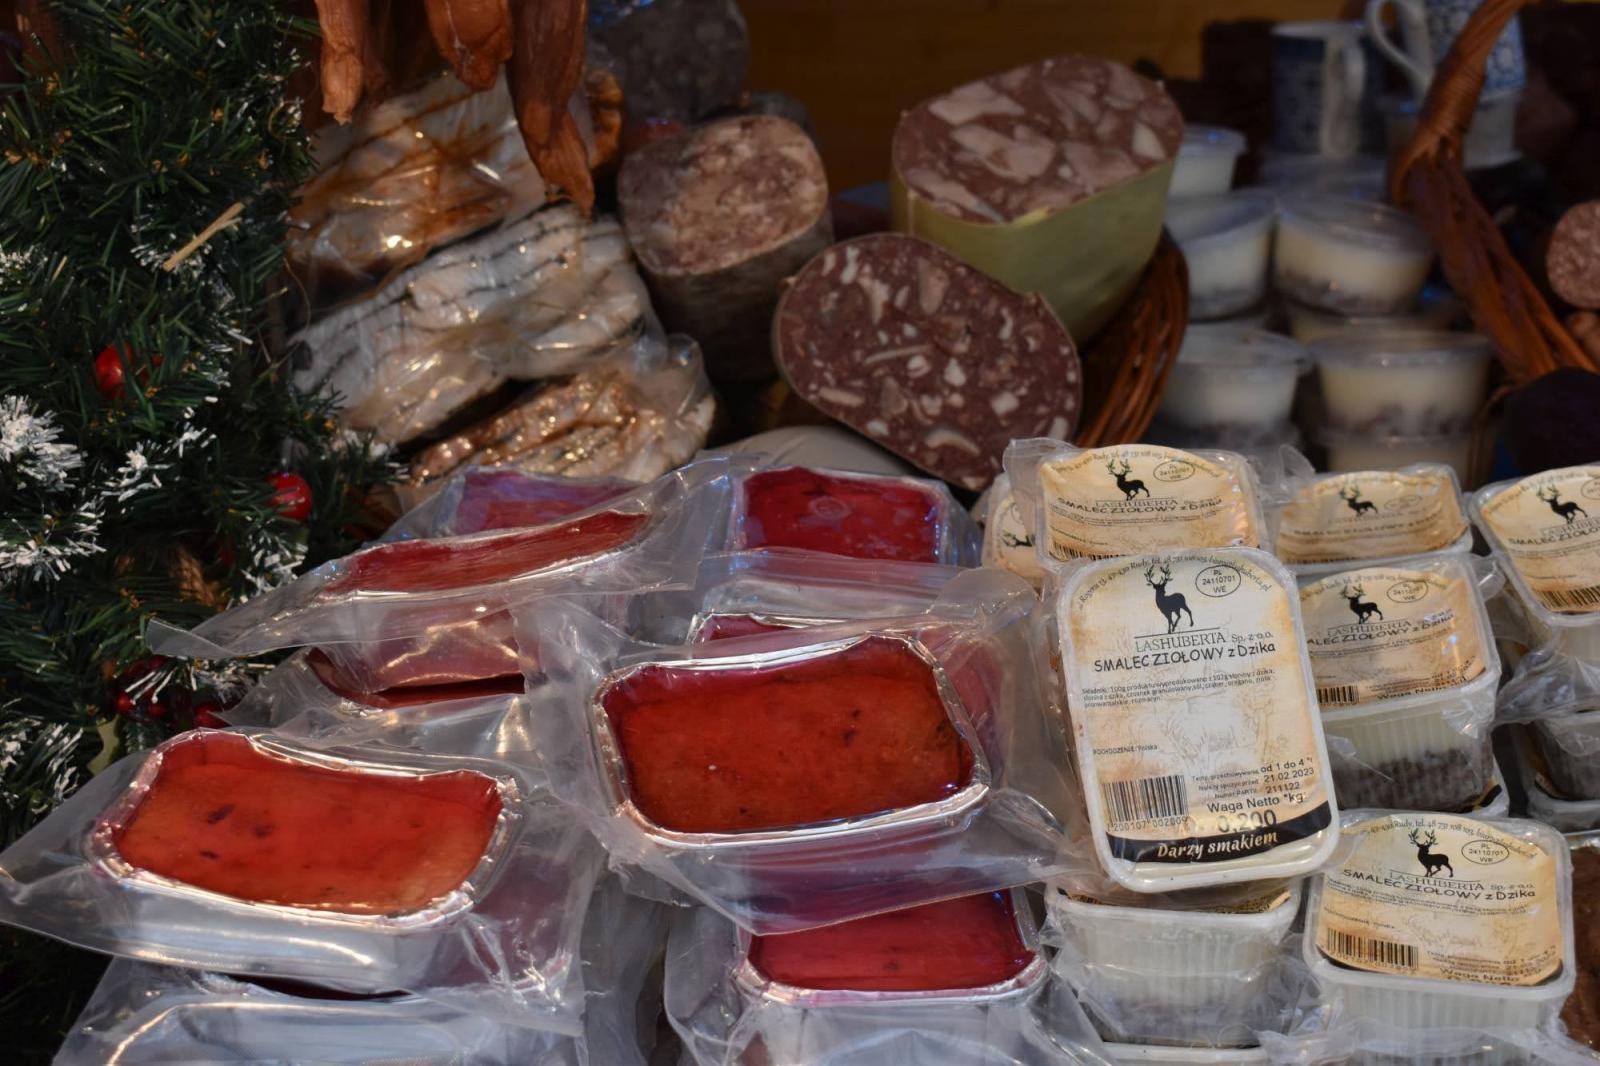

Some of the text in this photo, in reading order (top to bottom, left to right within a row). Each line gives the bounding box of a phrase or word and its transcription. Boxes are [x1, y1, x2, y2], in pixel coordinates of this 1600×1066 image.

[1057, 497, 1109, 513] SMALEC
[1111, 505, 1176, 514] ZIOŁOWY
[1187, 498, 1223, 510] Dzika
[1095, 499, 1179, 507] LASHUBERTA
[1202, 575, 1236, 585] 24110701
[1213, 585, 1227, 593] WE
[1327, 620, 1412, 637] LASHUBERTA
[1342, 627, 1409, 643] ZIOŁOWY
[1135, 631, 1227, 653] LASHUBERTA
[1231, 633, 1246, 644] Sp.
[1094, 641, 1276, 673] SMALEC ZIOŁOWY z Dzika
[1260, 763, 1273, 774] od
[1276, 762, 1281, 771] 1
[1284, 760, 1296, 770] do
[1298, 758, 1305, 767] 4
[1265, 781, 1301, 795] 211122
[1207, 801, 1243, 815] Waga
[1246, 796, 1280, 809] Netto
[1217, 808, 1278, 834] 0,200
[1157, 831, 1279, 860] Darzy smakiem
[1343, 869, 1401, 888] SMALEC
[1405, 883, 1482, 900] ZIOŁOWY
[1496, 889, 1536, 901] Dzika
[1390, 871, 1485, 891] LASHUBERTA
